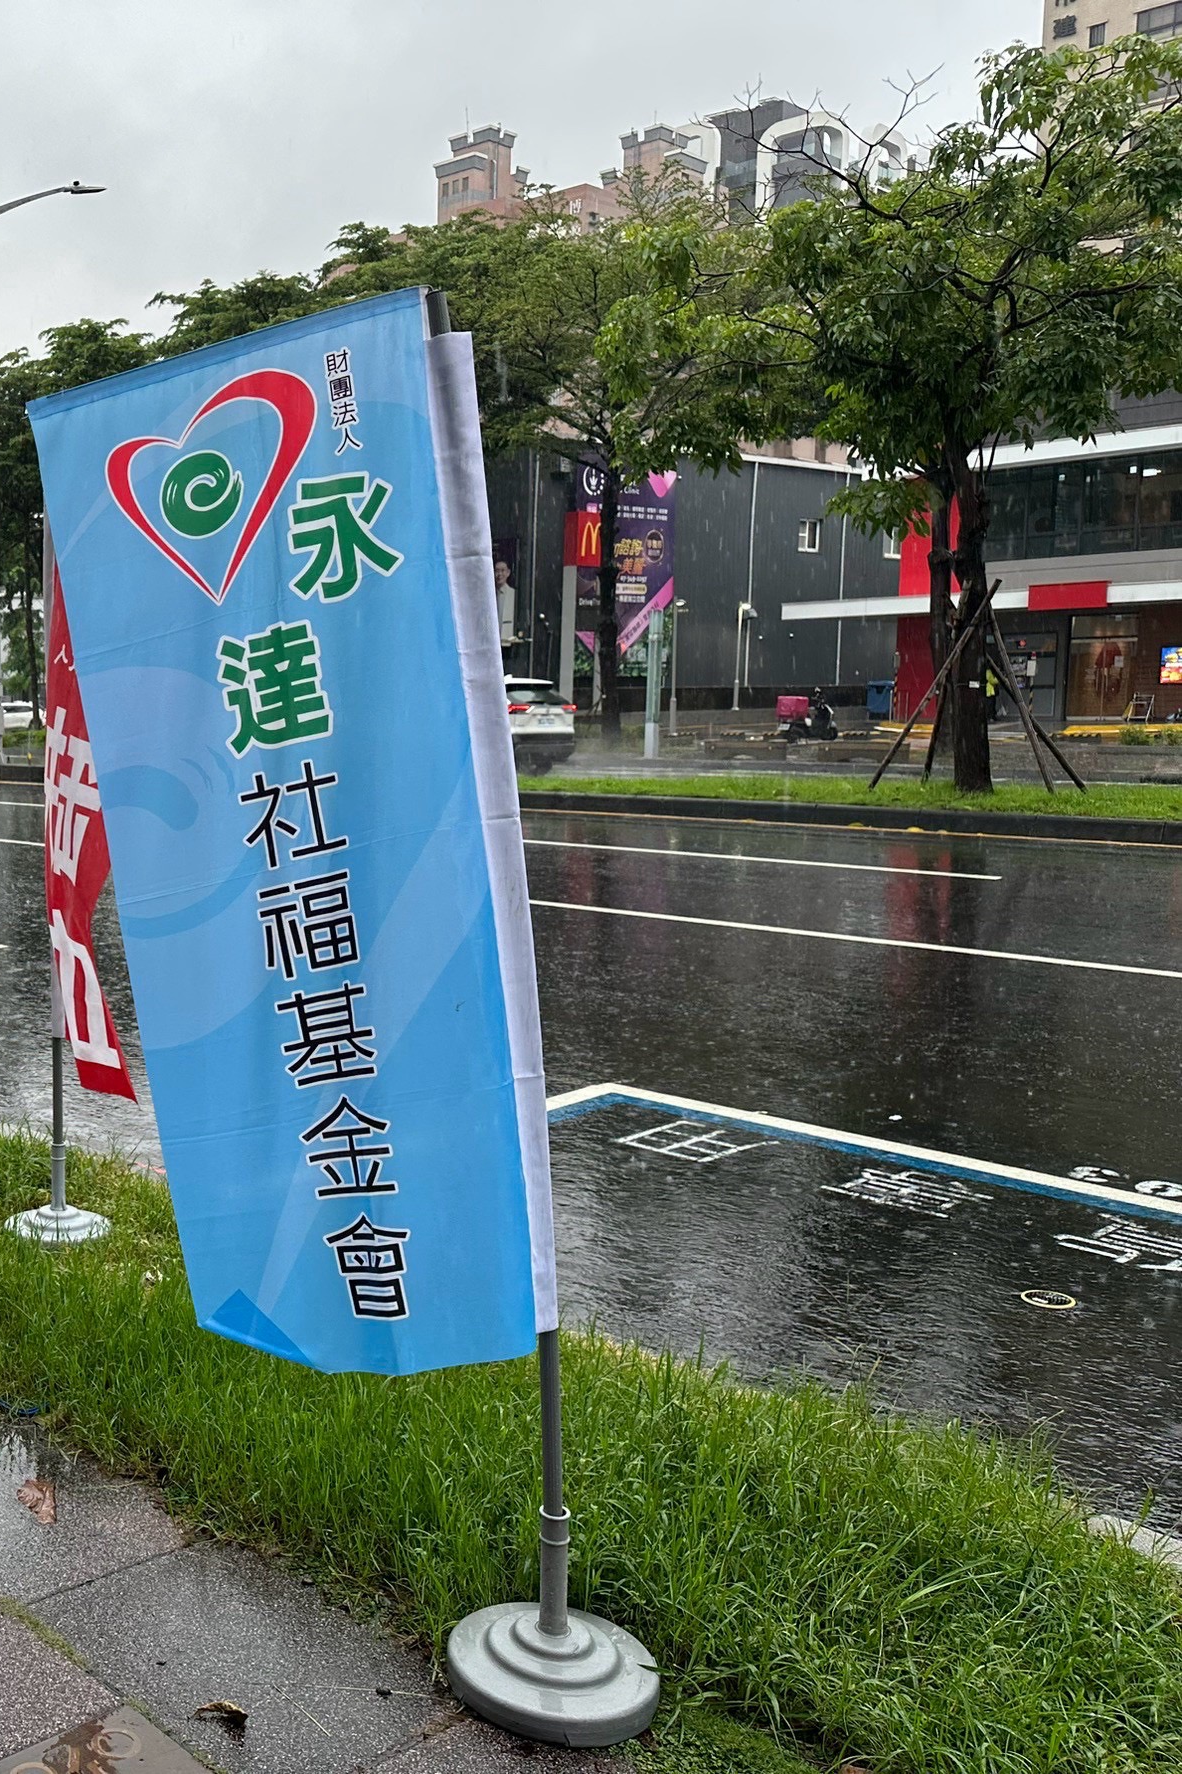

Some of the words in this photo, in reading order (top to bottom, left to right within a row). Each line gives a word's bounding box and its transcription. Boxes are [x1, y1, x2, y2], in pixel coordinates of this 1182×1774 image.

[325, 347, 362, 454] 財團法人
[218, 473, 409, 1319] 永達社福基金會
